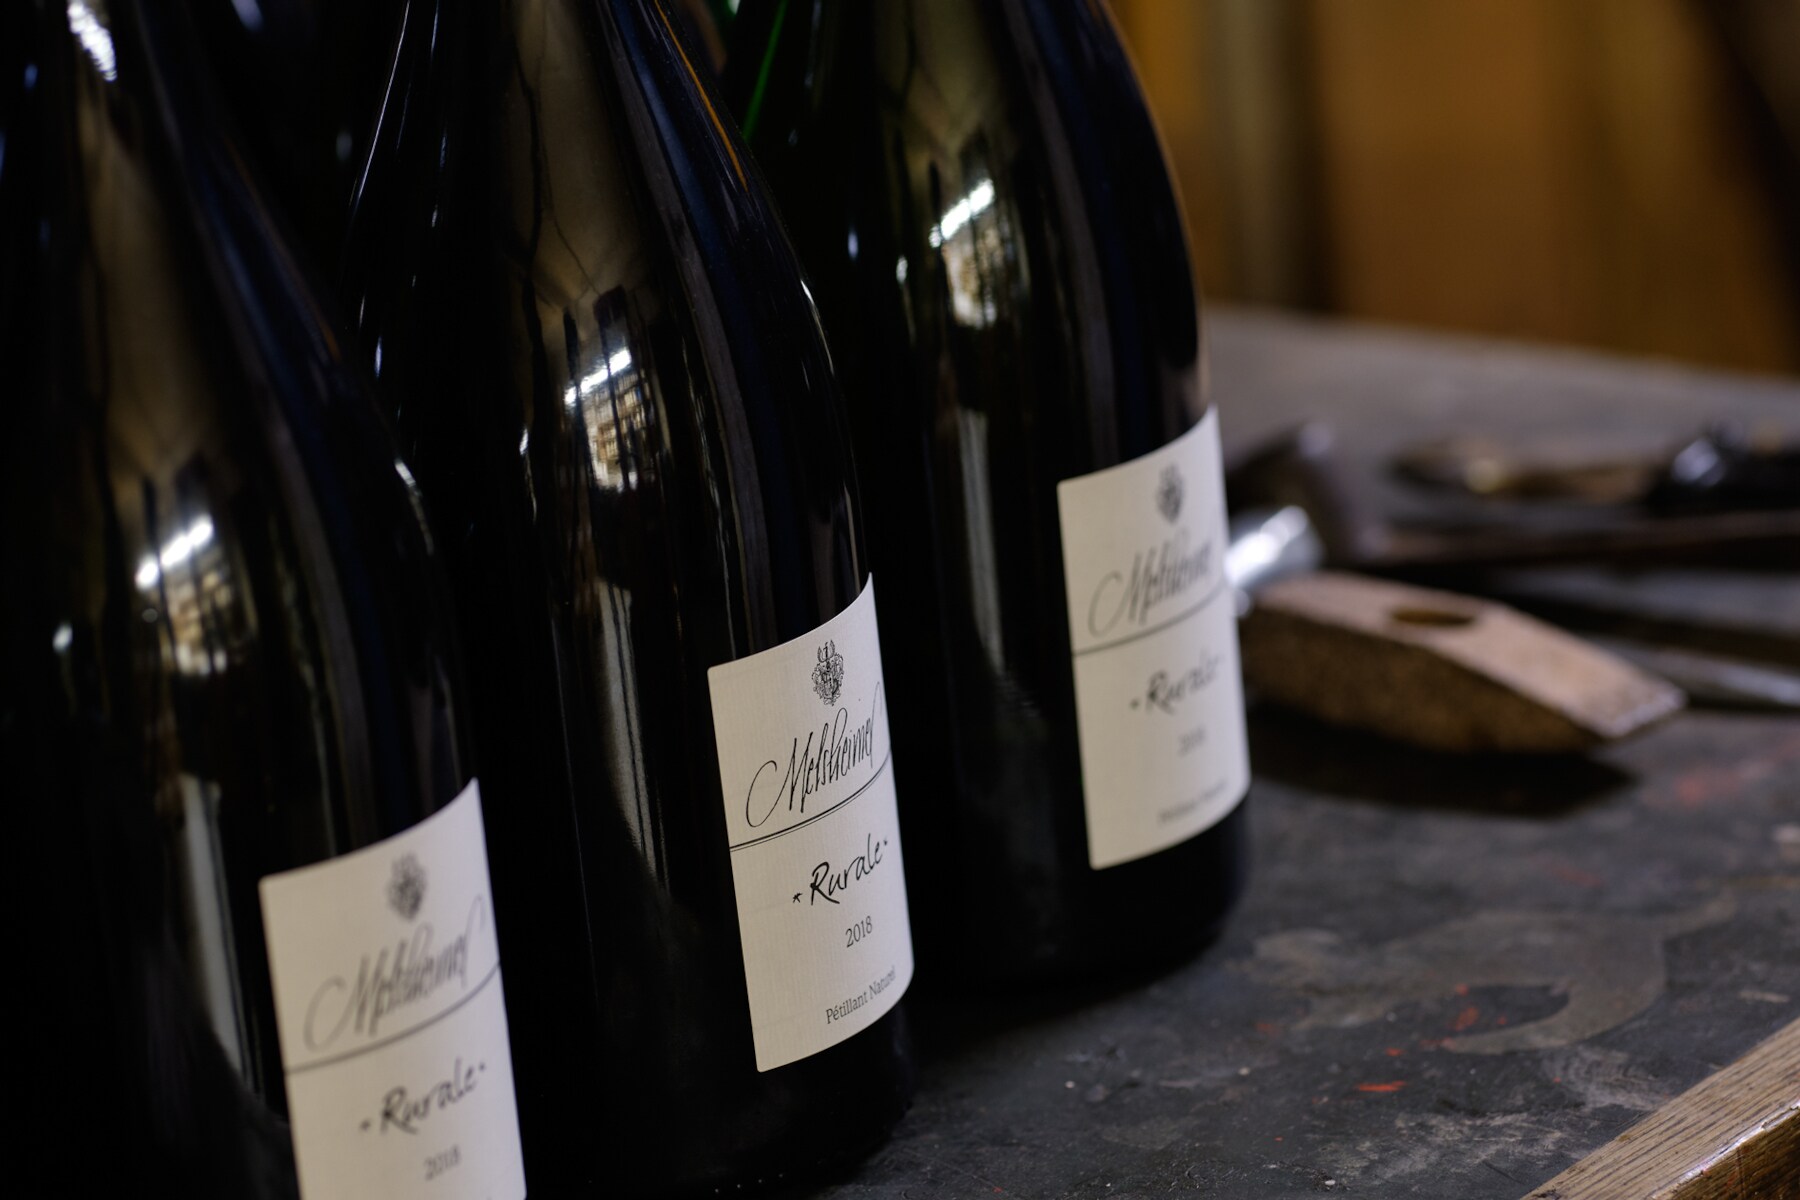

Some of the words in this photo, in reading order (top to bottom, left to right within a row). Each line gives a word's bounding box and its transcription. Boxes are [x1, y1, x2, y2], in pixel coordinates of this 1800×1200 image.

[746, 681, 882, 828] Melsheimer
[845, 915, 873, 948] 2018
[825, 991, 868, 1025] Pétillant
